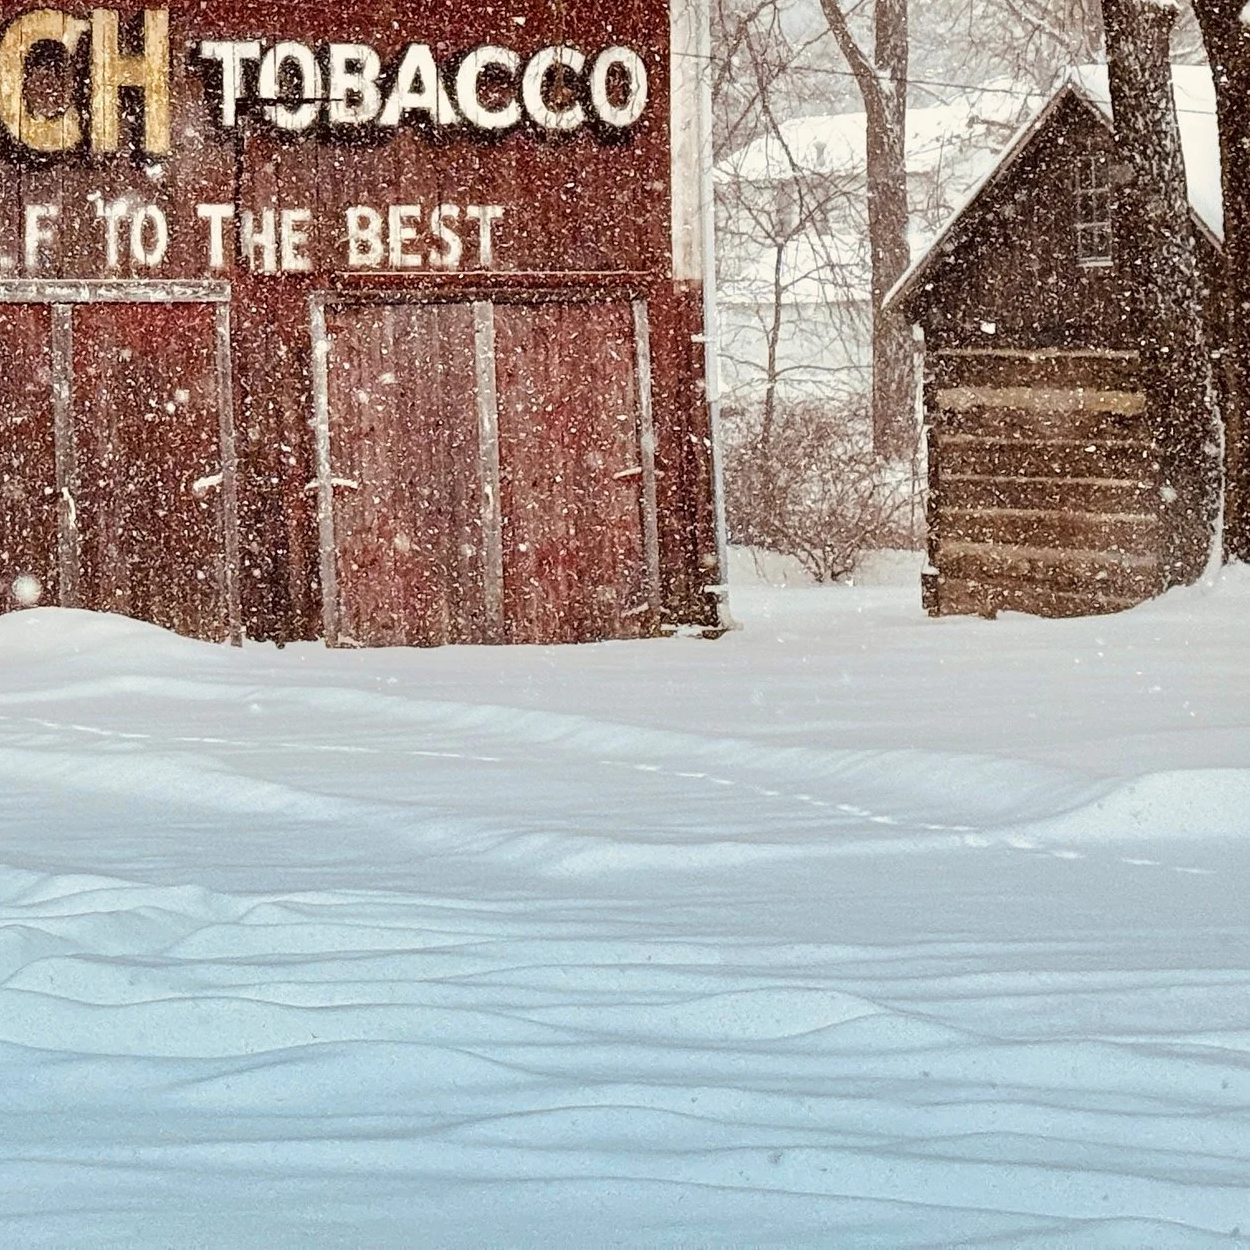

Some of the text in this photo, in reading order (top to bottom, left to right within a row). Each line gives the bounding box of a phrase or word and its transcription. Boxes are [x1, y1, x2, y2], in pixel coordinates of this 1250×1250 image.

[200, 40, 648, 130] TOBACCO
[92, 196, 168, 268] TO
[197, 203, 312, 273] THE
[345, 204, 504, 269] BEST
